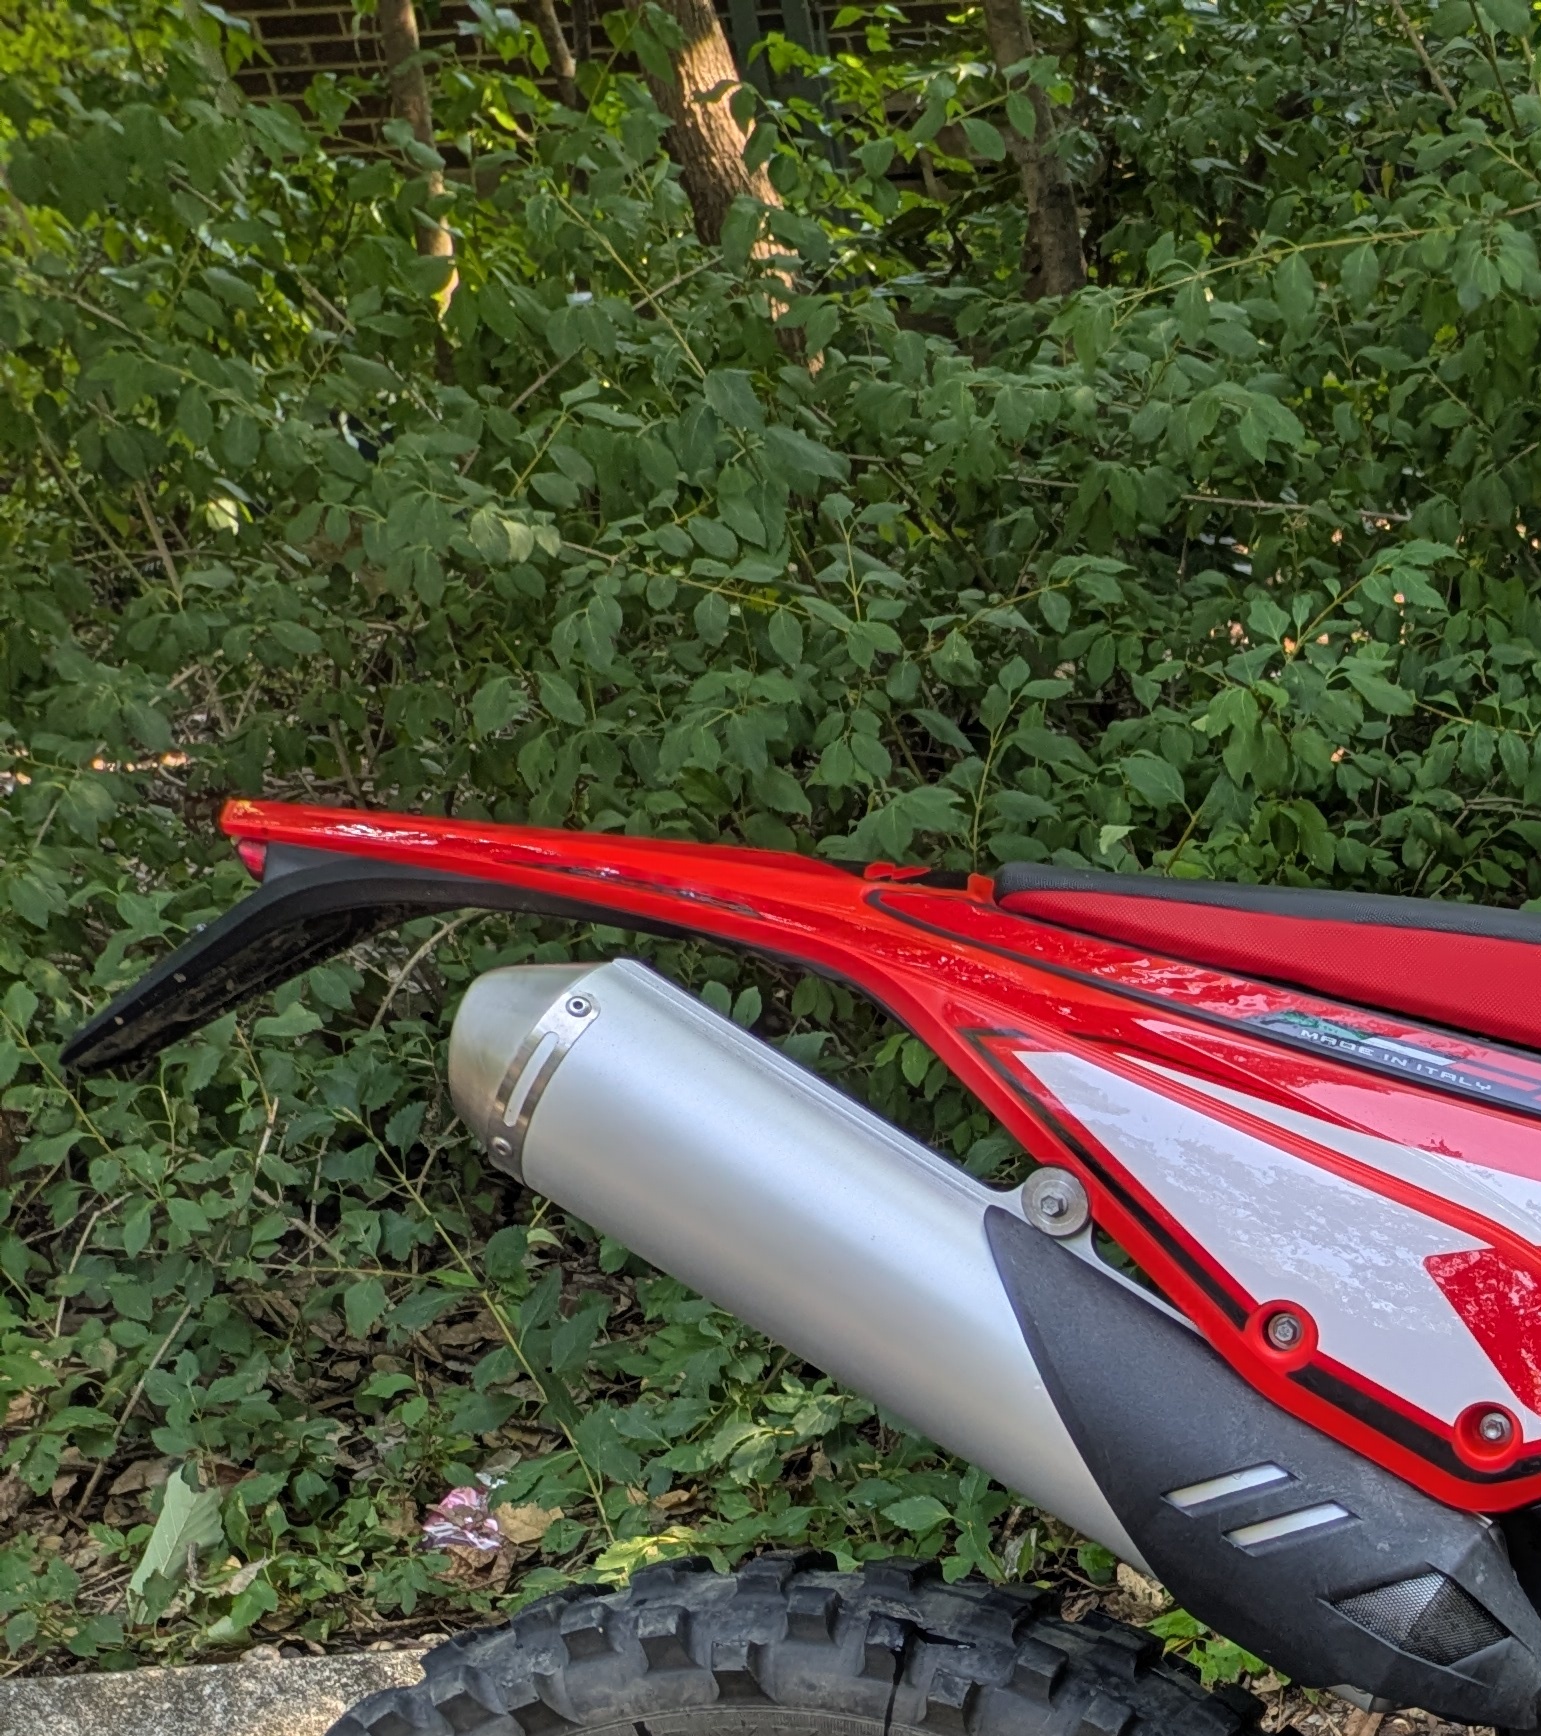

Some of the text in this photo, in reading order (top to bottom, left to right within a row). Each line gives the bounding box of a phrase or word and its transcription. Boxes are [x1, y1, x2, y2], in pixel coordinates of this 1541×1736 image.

[1300, 1029, 1493, 1091] MADE IN ITALY
